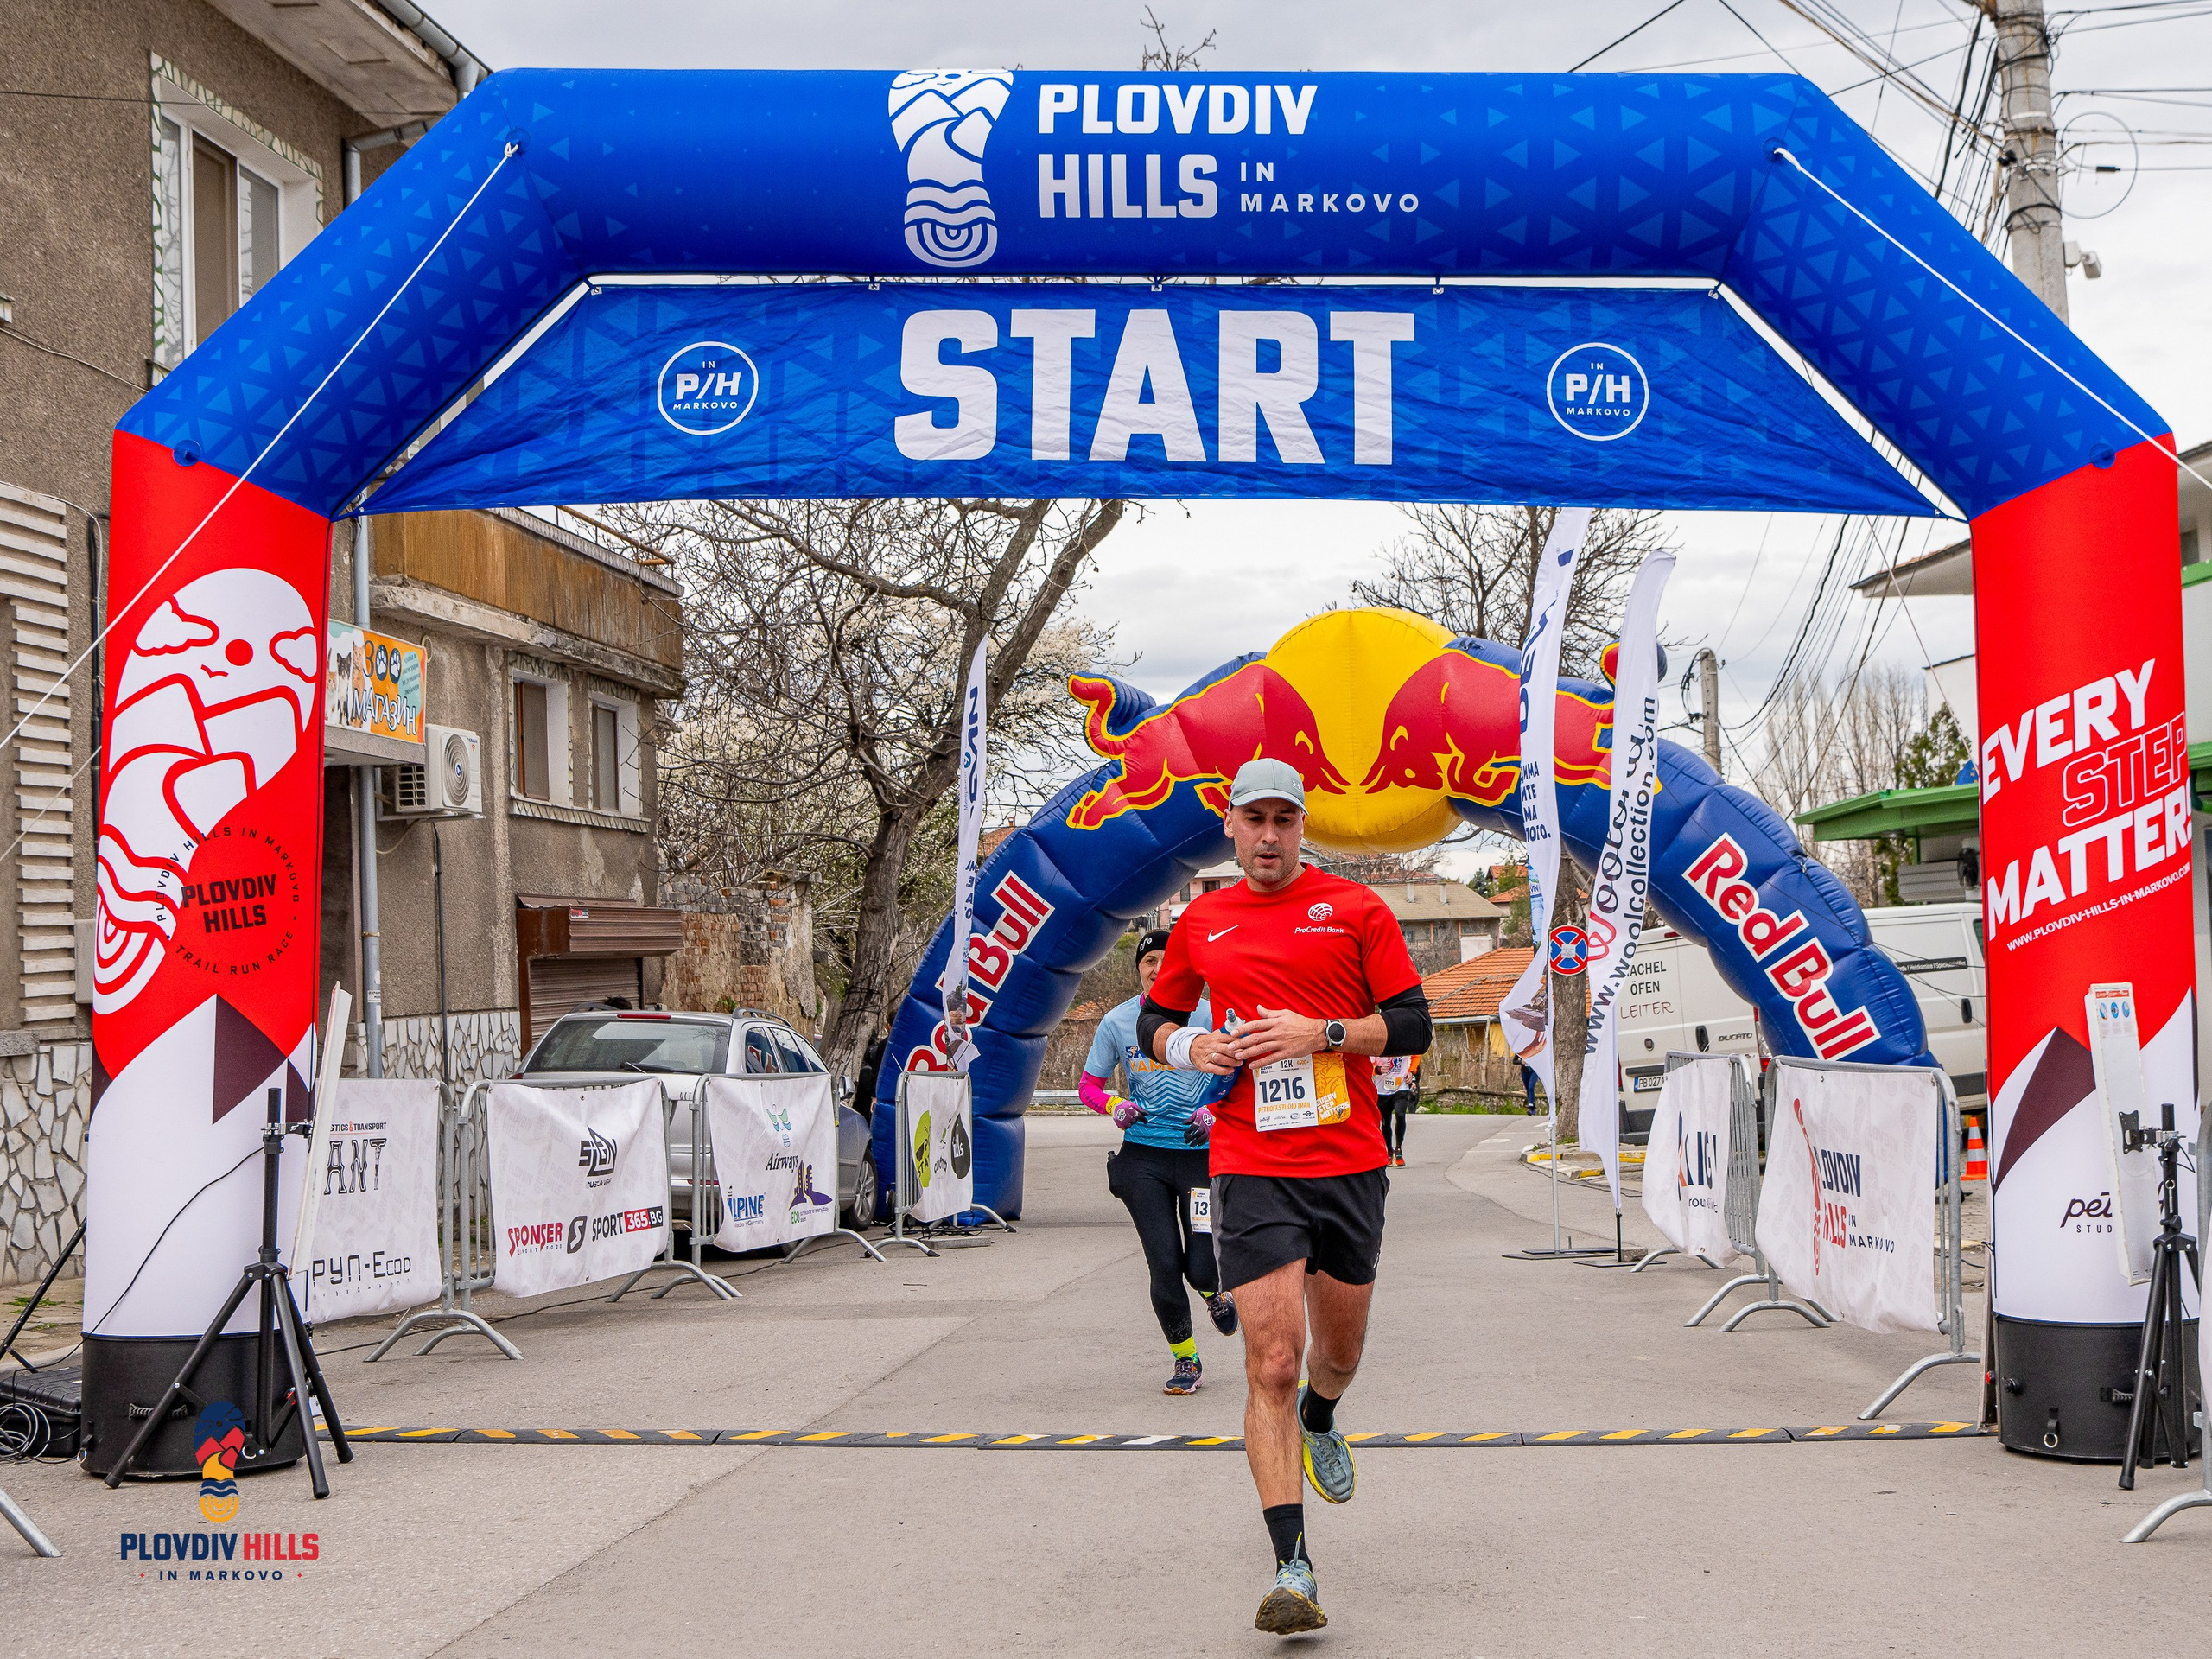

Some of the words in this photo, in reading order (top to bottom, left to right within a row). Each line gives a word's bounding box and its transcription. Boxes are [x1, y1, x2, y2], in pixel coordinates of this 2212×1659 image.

[1039, 84, 1319, 135] PLOVDIV
[1039, 154, 1217, 218] HILLS
[1240, 162, 1274, 181] IN
[1240, 194, 1420, 213] MARKOVO
[676, 372, 741, 400] P/H
[894, 308, 1415, 465] START
[1566, 373, 1630, 404] P/H
[1566, 407, 1630, 416] MARKOVO
[352, 687, 416, 735] МАГАЗИН
[1982, 658, 2156, 805] EVERY
[2063, 711, 2188, 828] STEP
[156, 853, 180, 922] PLOVDIV
[183, 827, 232, 851] HILLS
[241, 827, 258, 839] IN
[264, 836, 300, 903] MARKOVO
[181, 874, 276, 908] PLOVDIV
[2007, 861, 2190, 951] WWW.PLOVDIV-HILLS-IN-MARKOVO.COM
[203, 904, 267, 934] HILLS
[175, 944, 219, 975] TRAIL
[230, 962, 261, 976] RUN
[266, 931, 294, 964] RACE
[1684, 835, 1808, 960] Red
[1767, 940, 1878, 1060] Bull
[1627, 961, 1667, 977] ACHEL
[1630, 980, 1661, 995] ÖFEN
[1620, 1001, 1674, 1020] LEITER
[1718, 1033, 1753, 1042] DUCATO
[1281, 1059, 1294, 1068] 12K
[1259, 1077, 1306, 1103] 1216
[321, 1138, 387, 1196] ANT
[766, 1153, 799, 1173] Airways
[1848, 1214, 1857, 1228] IN
[2076, 1224, 2113, 1233] STUD
[508, 1222, 563, 1257] SPONSER
[1849, 1233, 1895, 1254] MARKOVO
